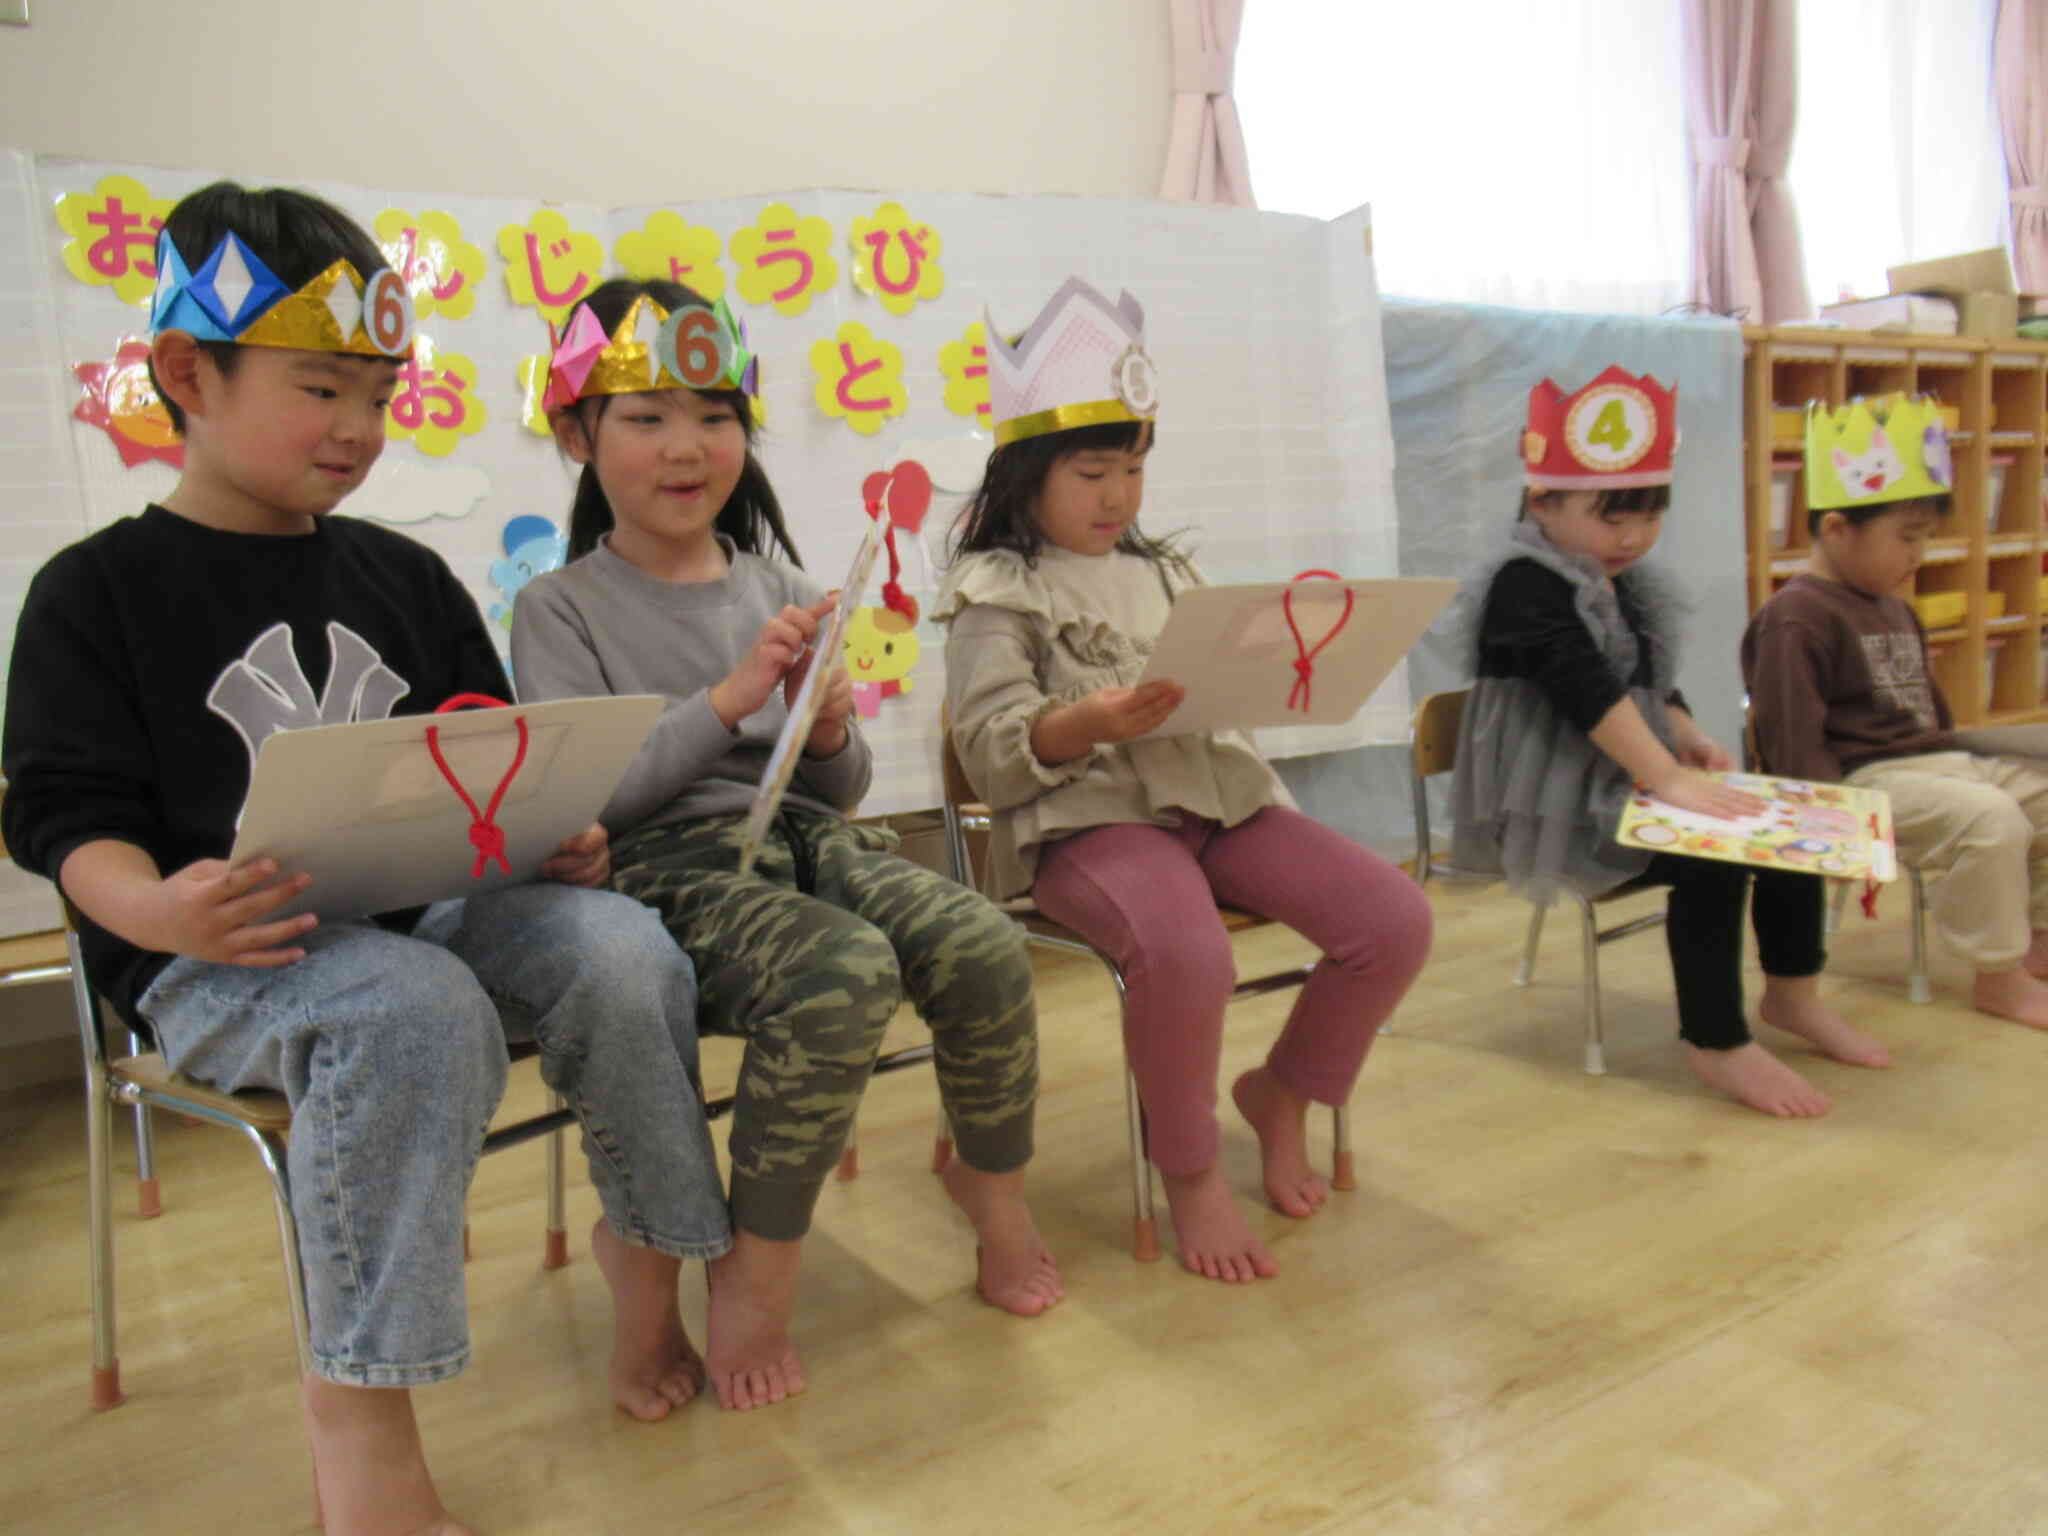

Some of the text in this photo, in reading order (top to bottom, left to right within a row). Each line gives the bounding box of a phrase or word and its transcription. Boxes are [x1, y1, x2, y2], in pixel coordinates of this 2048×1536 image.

[373, 271, 406, 350] 6
[676, 311, 720, 384] 6
[1587, 400, 1632, 452] 4
